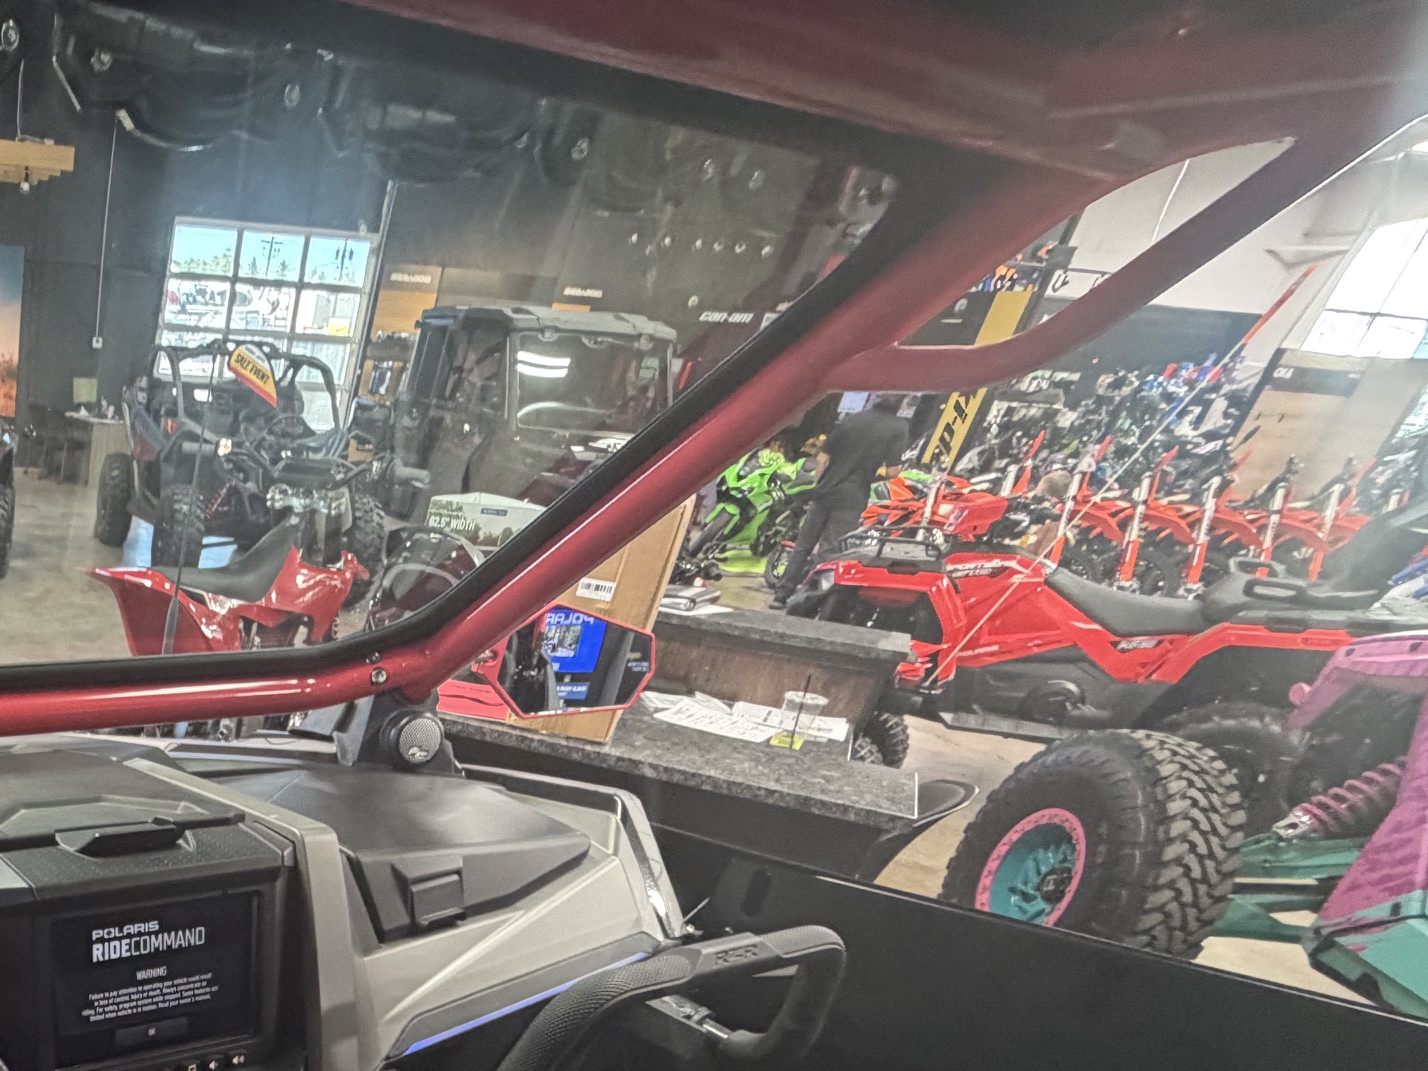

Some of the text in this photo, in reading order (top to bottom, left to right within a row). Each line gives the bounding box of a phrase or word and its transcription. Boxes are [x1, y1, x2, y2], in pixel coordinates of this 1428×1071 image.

[234, 353, 252, 371] SALE
[249, 364, 271, 385] EVENT
[450, 517, 476, 531] WIDTH
[92, 920, 159, 941] POLARIS
[92, 926, 205, 963] RIDECOMMAND
[136, 966, 167, 980] WARNING
